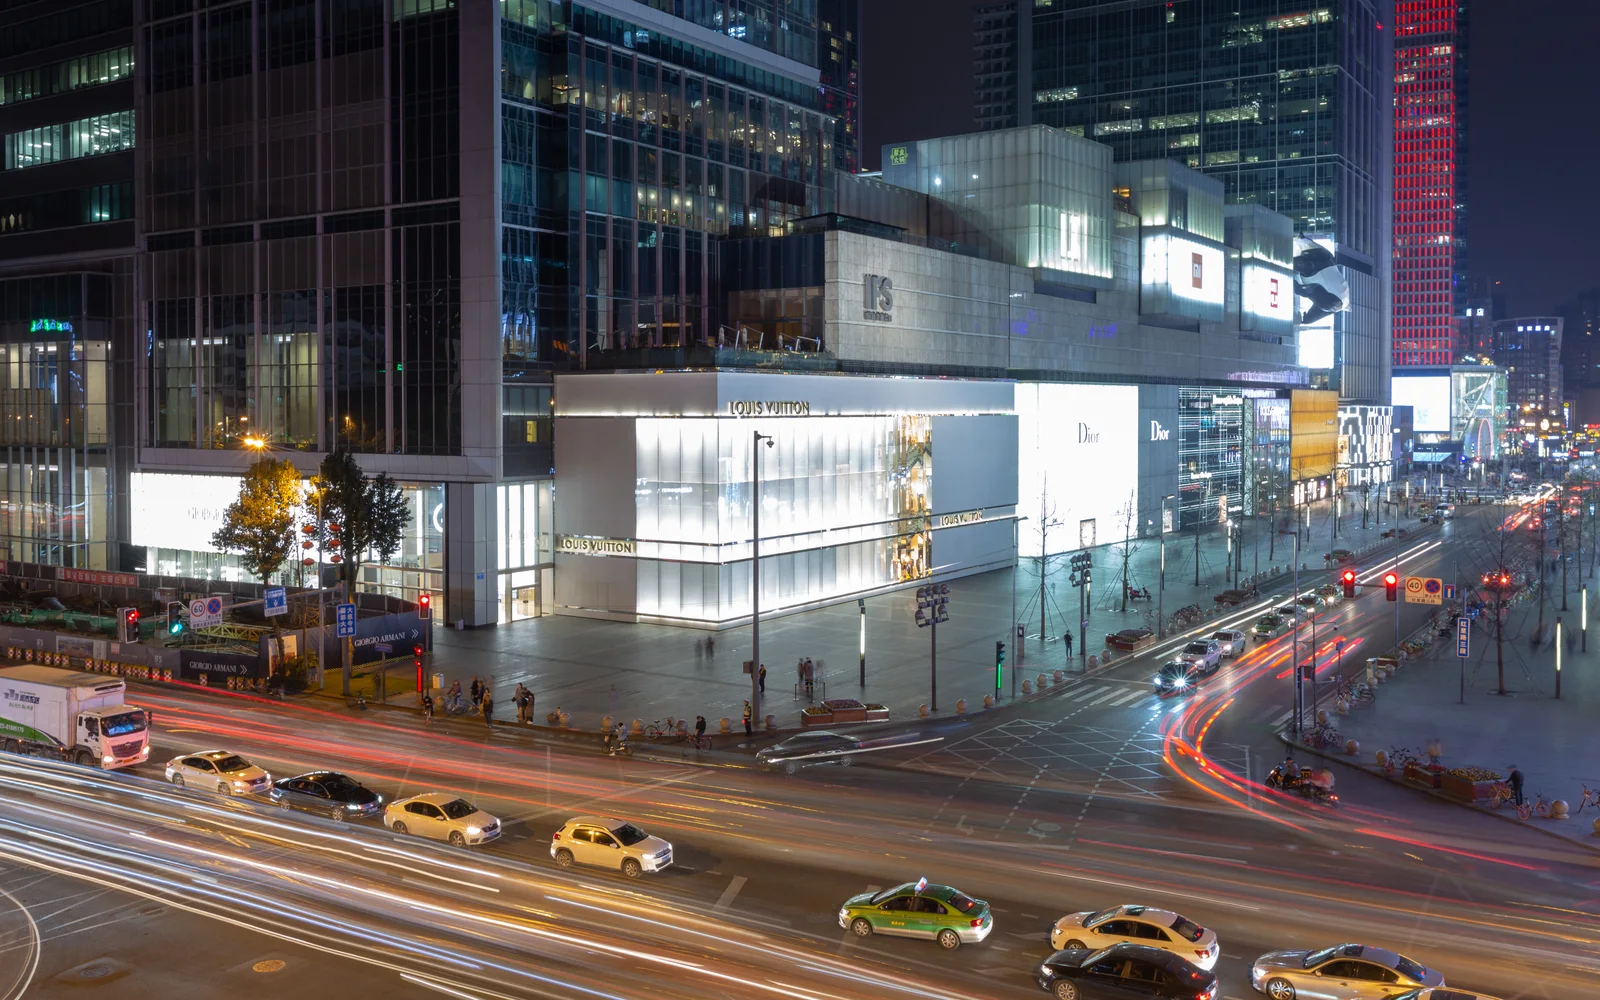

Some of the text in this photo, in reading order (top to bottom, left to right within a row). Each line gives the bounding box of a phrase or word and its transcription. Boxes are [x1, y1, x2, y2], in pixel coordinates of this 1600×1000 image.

[863, 274, 893, 311] IFS
[729, 401, 810, 416] LOUIS VUITTON
[1078, 422, 1100, 444] Dior
[1151, 420, 1170, 441] Dior
[941, 514, 959, 526] LOUIS
[561, 539, 632, 553] LOUIS VUITTON
[193, 604, 203, 614] 60
[354, 631, 406, 647] GIORGIO ARMANI
[189, 661, 237, 673] GIORGIO ARMANI
